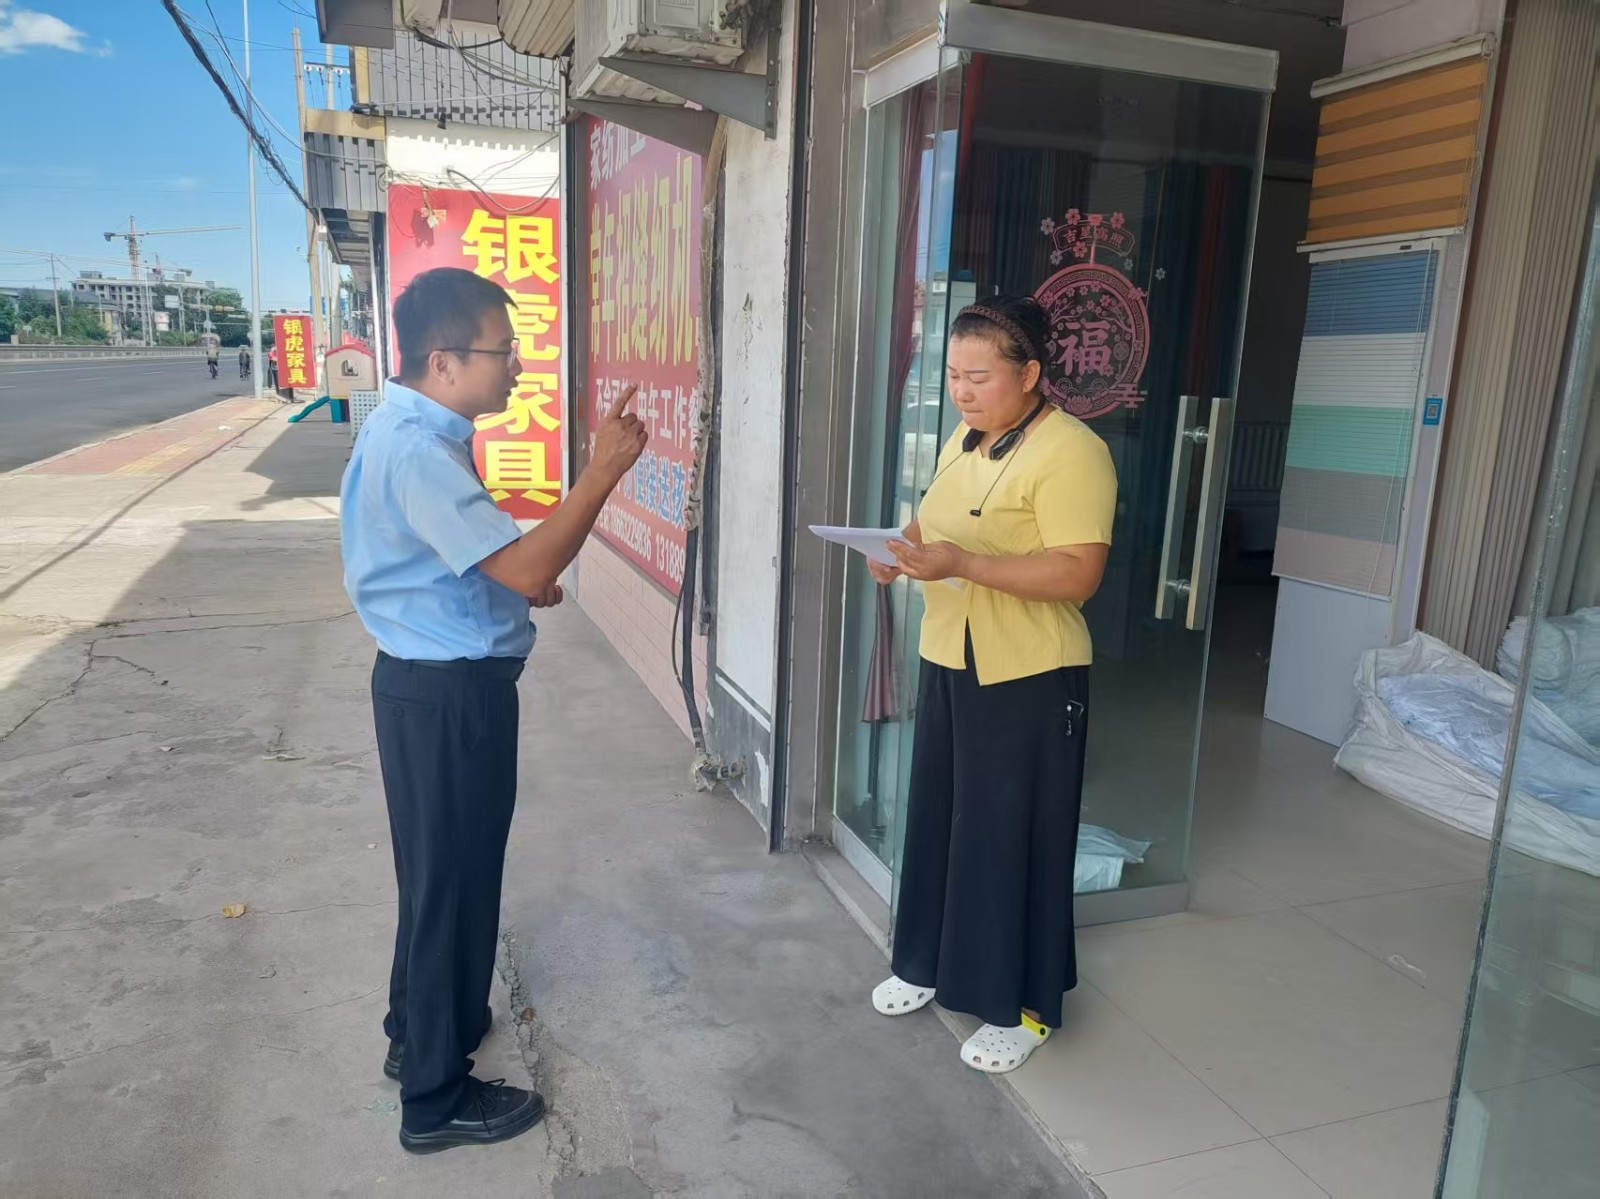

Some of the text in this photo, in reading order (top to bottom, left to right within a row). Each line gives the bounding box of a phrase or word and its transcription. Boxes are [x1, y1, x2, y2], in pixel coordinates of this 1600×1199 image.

[590, 151, 700, 368] 常年招缝纫机
[283, 318, 307, 384] 银虎家具
[1057, 320, 1112, 376] 福
